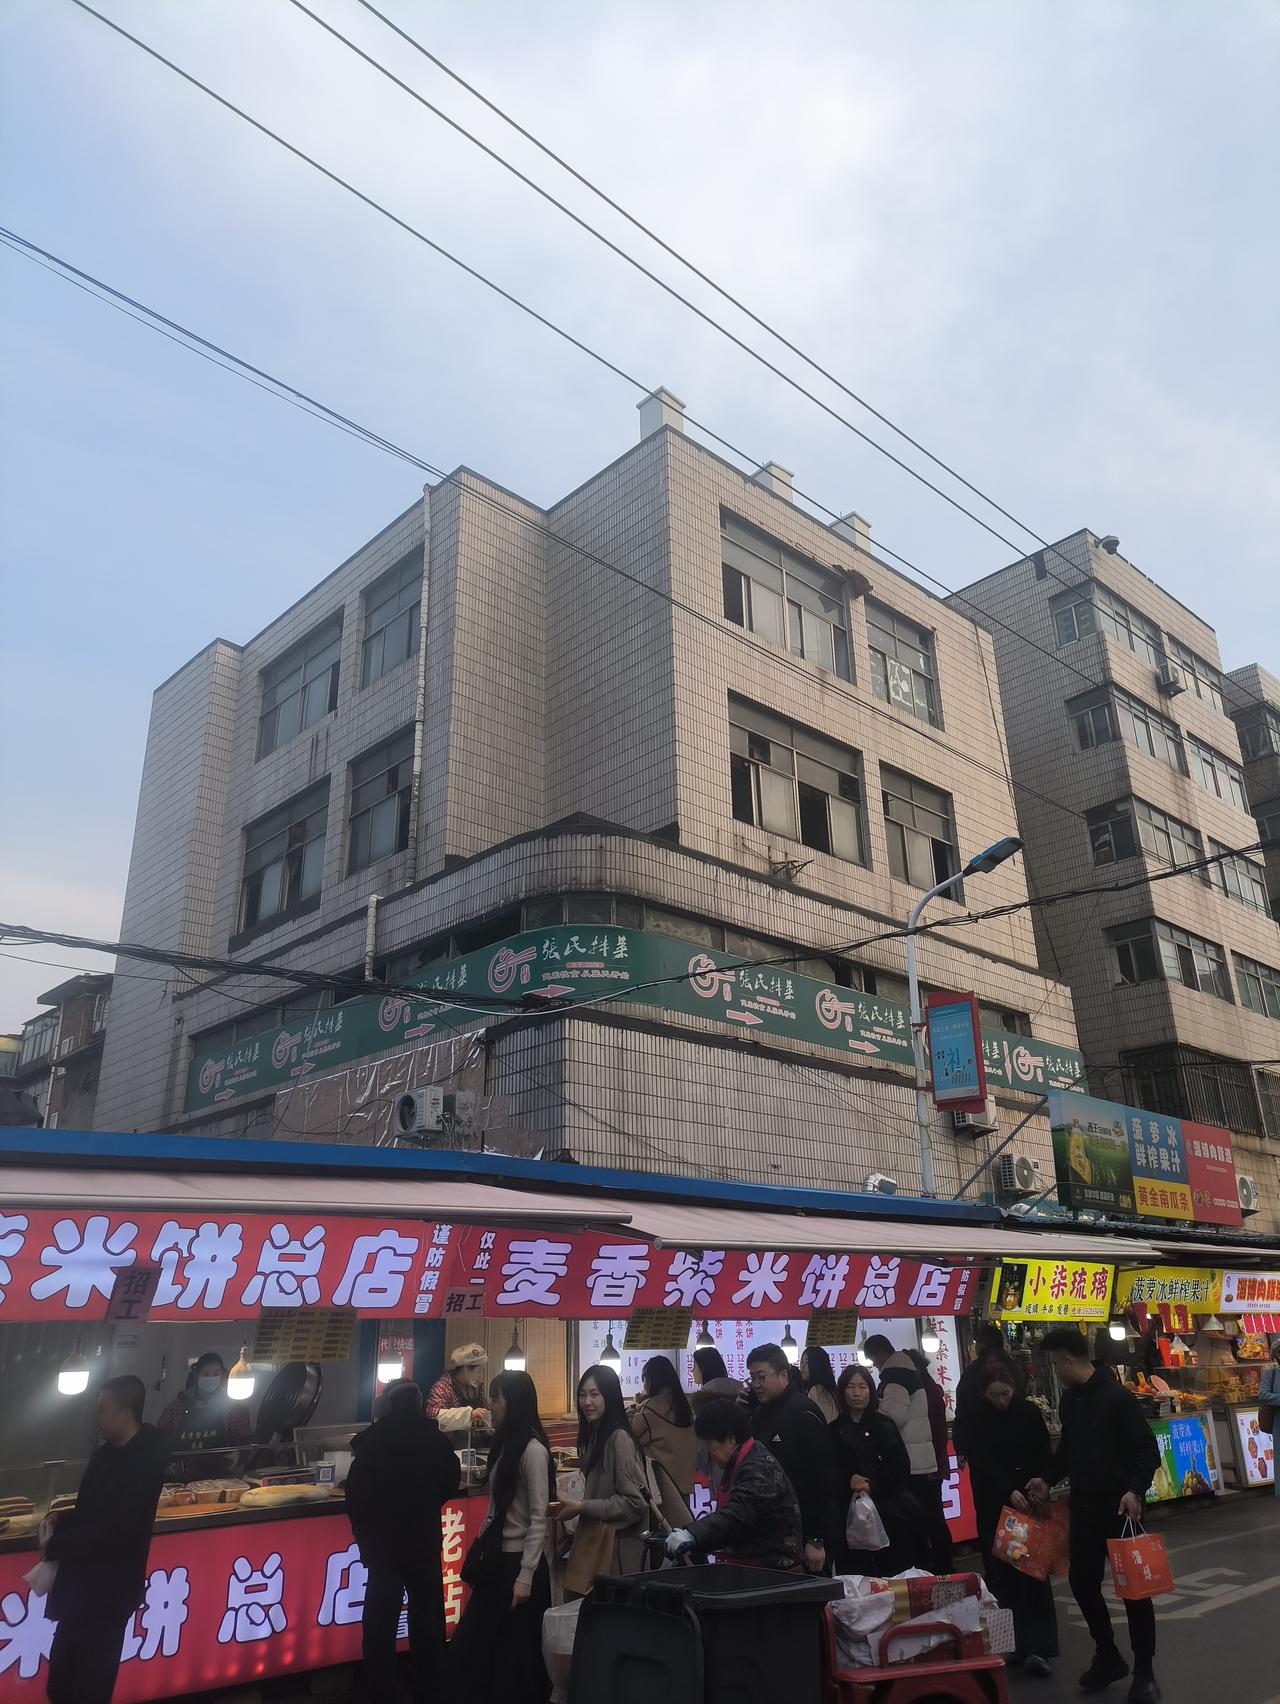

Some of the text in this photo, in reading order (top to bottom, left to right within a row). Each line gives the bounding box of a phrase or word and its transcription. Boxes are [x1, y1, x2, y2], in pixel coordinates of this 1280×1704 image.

[1134, 1142, 1180, 1174] 鲜榨果汁
[1137, 1185, 1190, 1212] 黄金南瓜条
[0, 1213, 419, 1309] 米饼总店
[414, 1223, 453, 1314] 谨防假冒
[495, 1238, 954, 1308] 麦香紫米饼总店
[1029, 1264, 1109, 1301] 小柒琉璃
[1132, 1276, 1210, 1302] 菠萝冰鲜榨果汁
[446, 1293, 484, 1313] 招工
